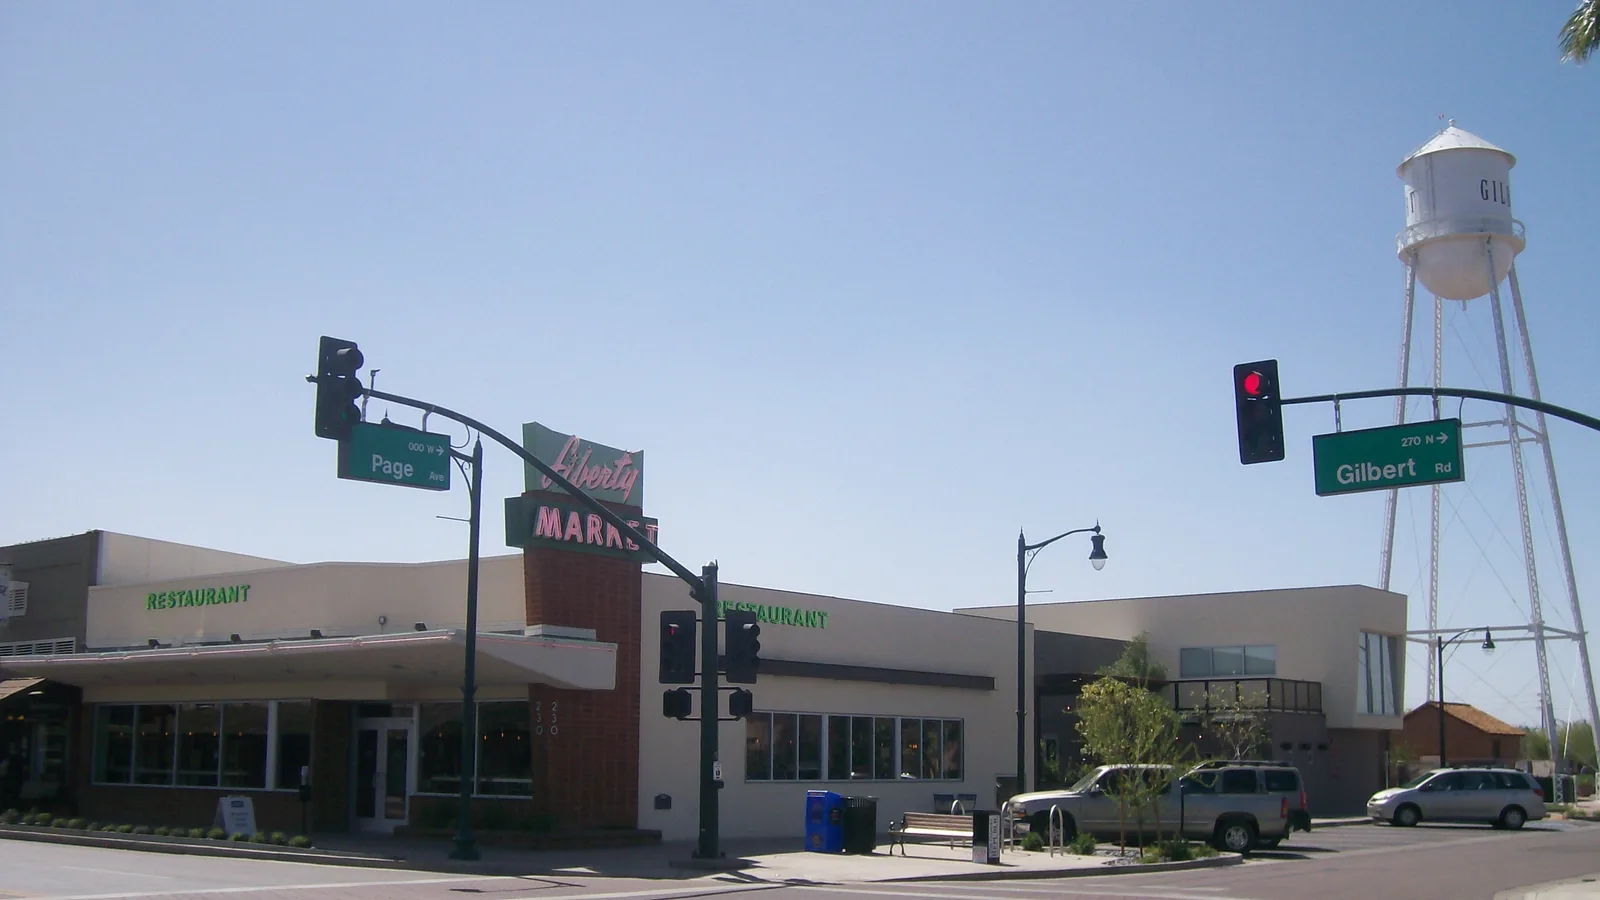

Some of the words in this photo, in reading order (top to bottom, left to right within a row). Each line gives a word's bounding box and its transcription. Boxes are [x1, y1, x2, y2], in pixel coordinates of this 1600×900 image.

[1480, 179, 1511, 208] GIL
[408, 441, 424, 453] 000
[426, 444, 435, 454] W
[1401, 436, 1421, 447] 270
[1425, 434, 1434, 445] N
[372, 454, 413, 479] Page
[429, 471, 444, 482] Ave
[541, 435, 639, 504] Liberty
[1336, 458, 1416, 484] Gilbert
[1435, 462, 1452, 473] Rd
[146, 584, 251, 610] RESTAURANT
[550, 701, 558, 735] 230
